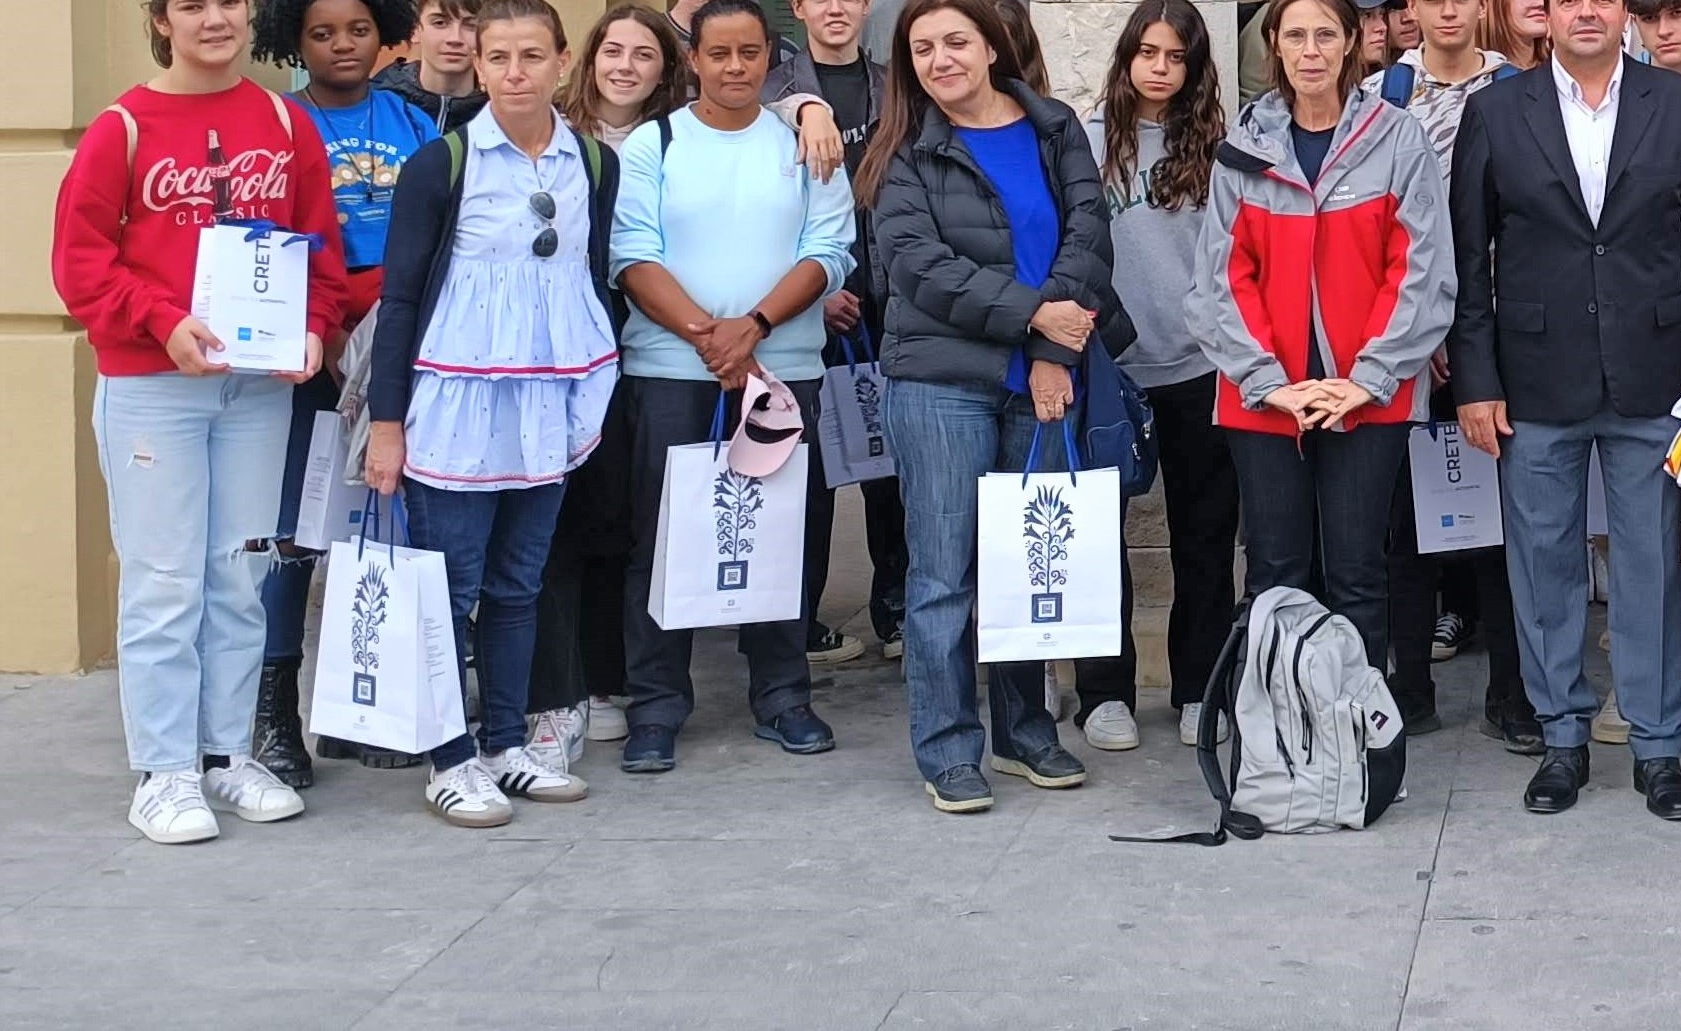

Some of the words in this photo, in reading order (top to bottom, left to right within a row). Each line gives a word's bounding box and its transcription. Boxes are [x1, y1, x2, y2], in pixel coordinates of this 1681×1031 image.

[364, 139, 398, 156] FOR
[175, 204, 269, 226] CLASIC
[1444, 424, 1462, 484] CRETE
